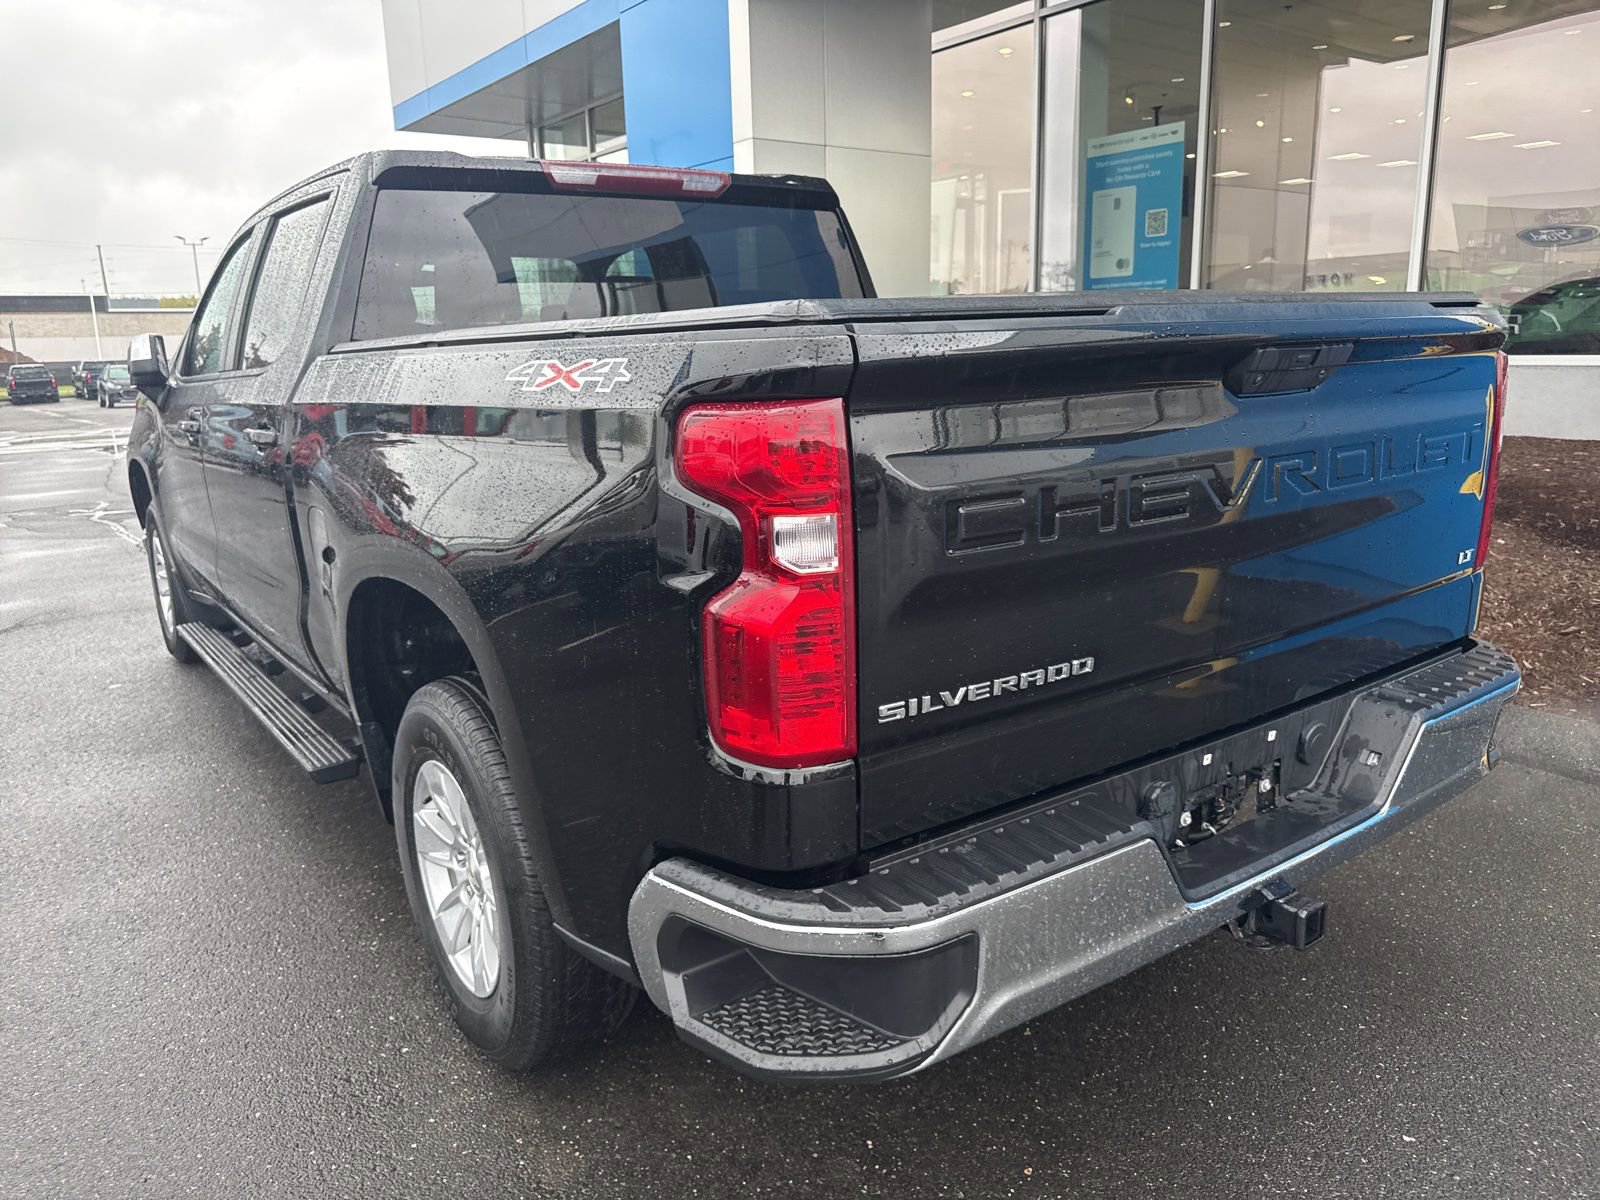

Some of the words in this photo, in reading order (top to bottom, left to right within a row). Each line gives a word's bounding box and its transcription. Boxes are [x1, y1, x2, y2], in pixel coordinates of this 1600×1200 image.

[944, 421, 1484, 556] CHEVROLET
[1457, 548, 1475, 565] LT
[877, 656, 1096, 724] SILVERADO
